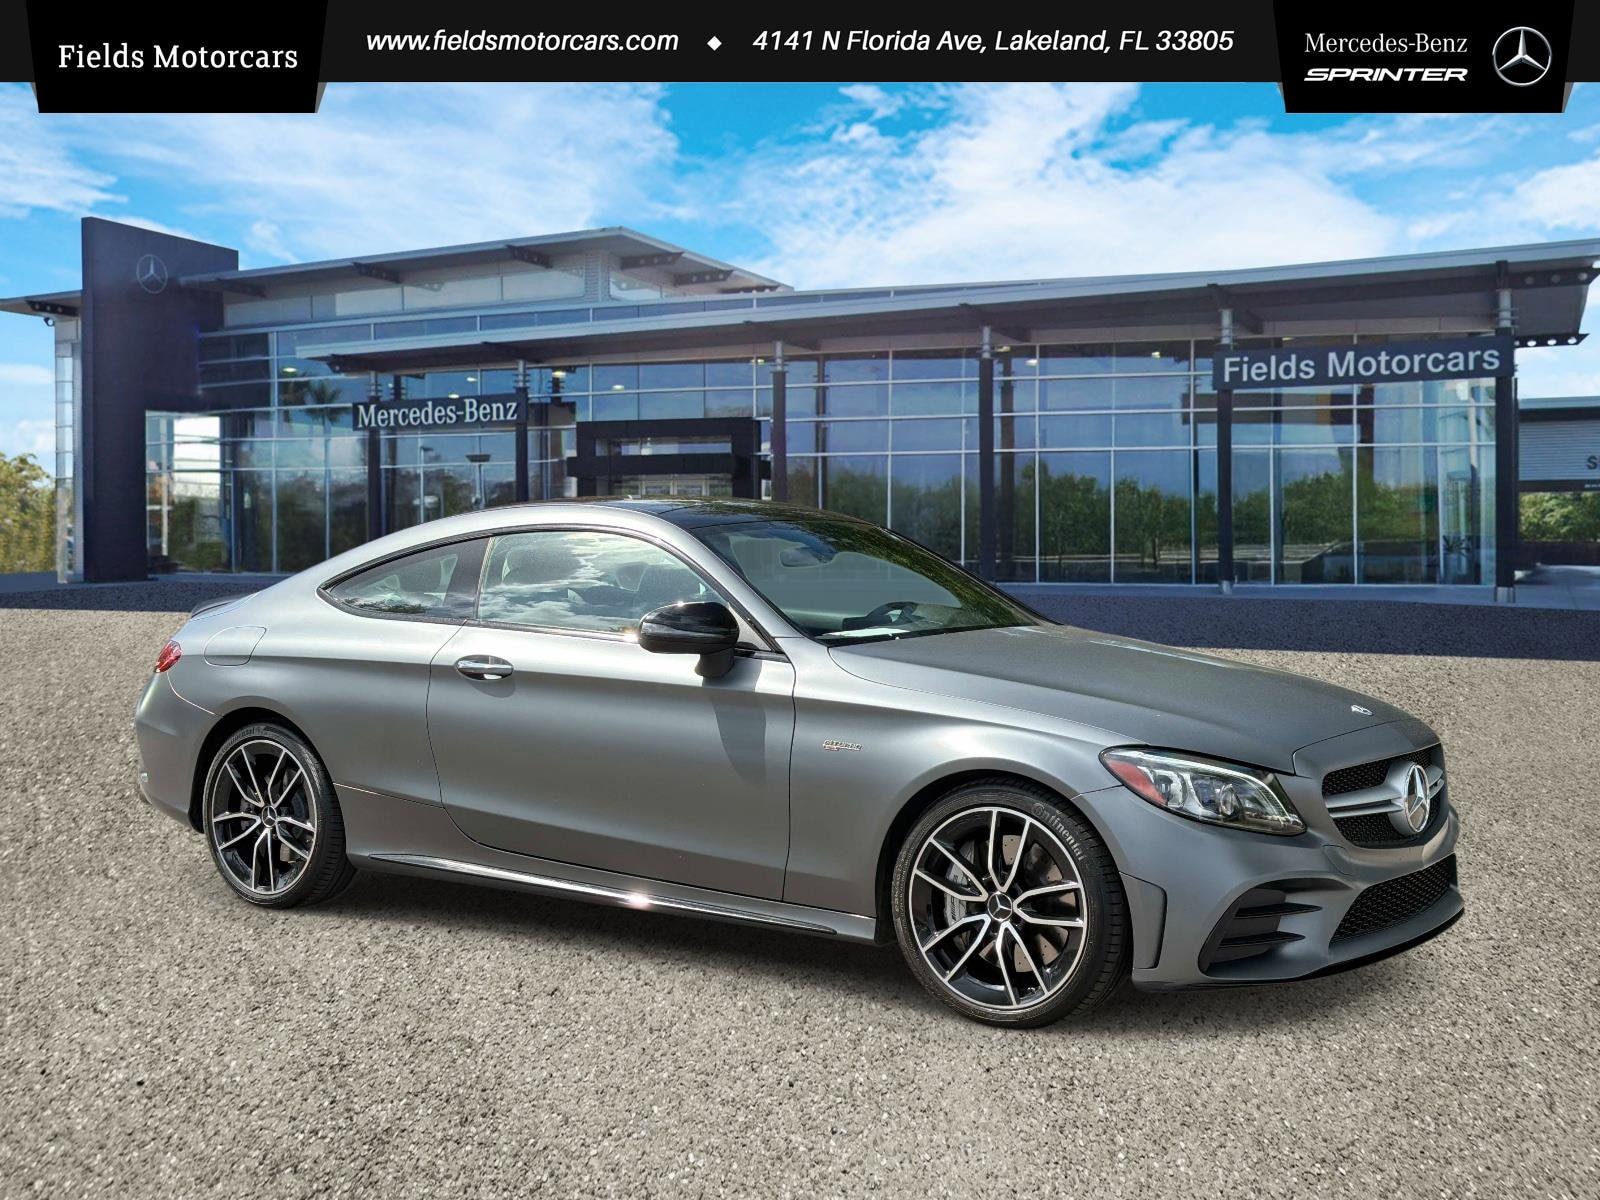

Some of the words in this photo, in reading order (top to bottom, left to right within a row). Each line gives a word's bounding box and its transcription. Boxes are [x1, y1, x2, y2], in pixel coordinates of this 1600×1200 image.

[1223, 353, 1316, 383] Fields
[1327, 348, 1501, 379] Motorcars
[357, 398, 518, 429] Mercedes-Benz
